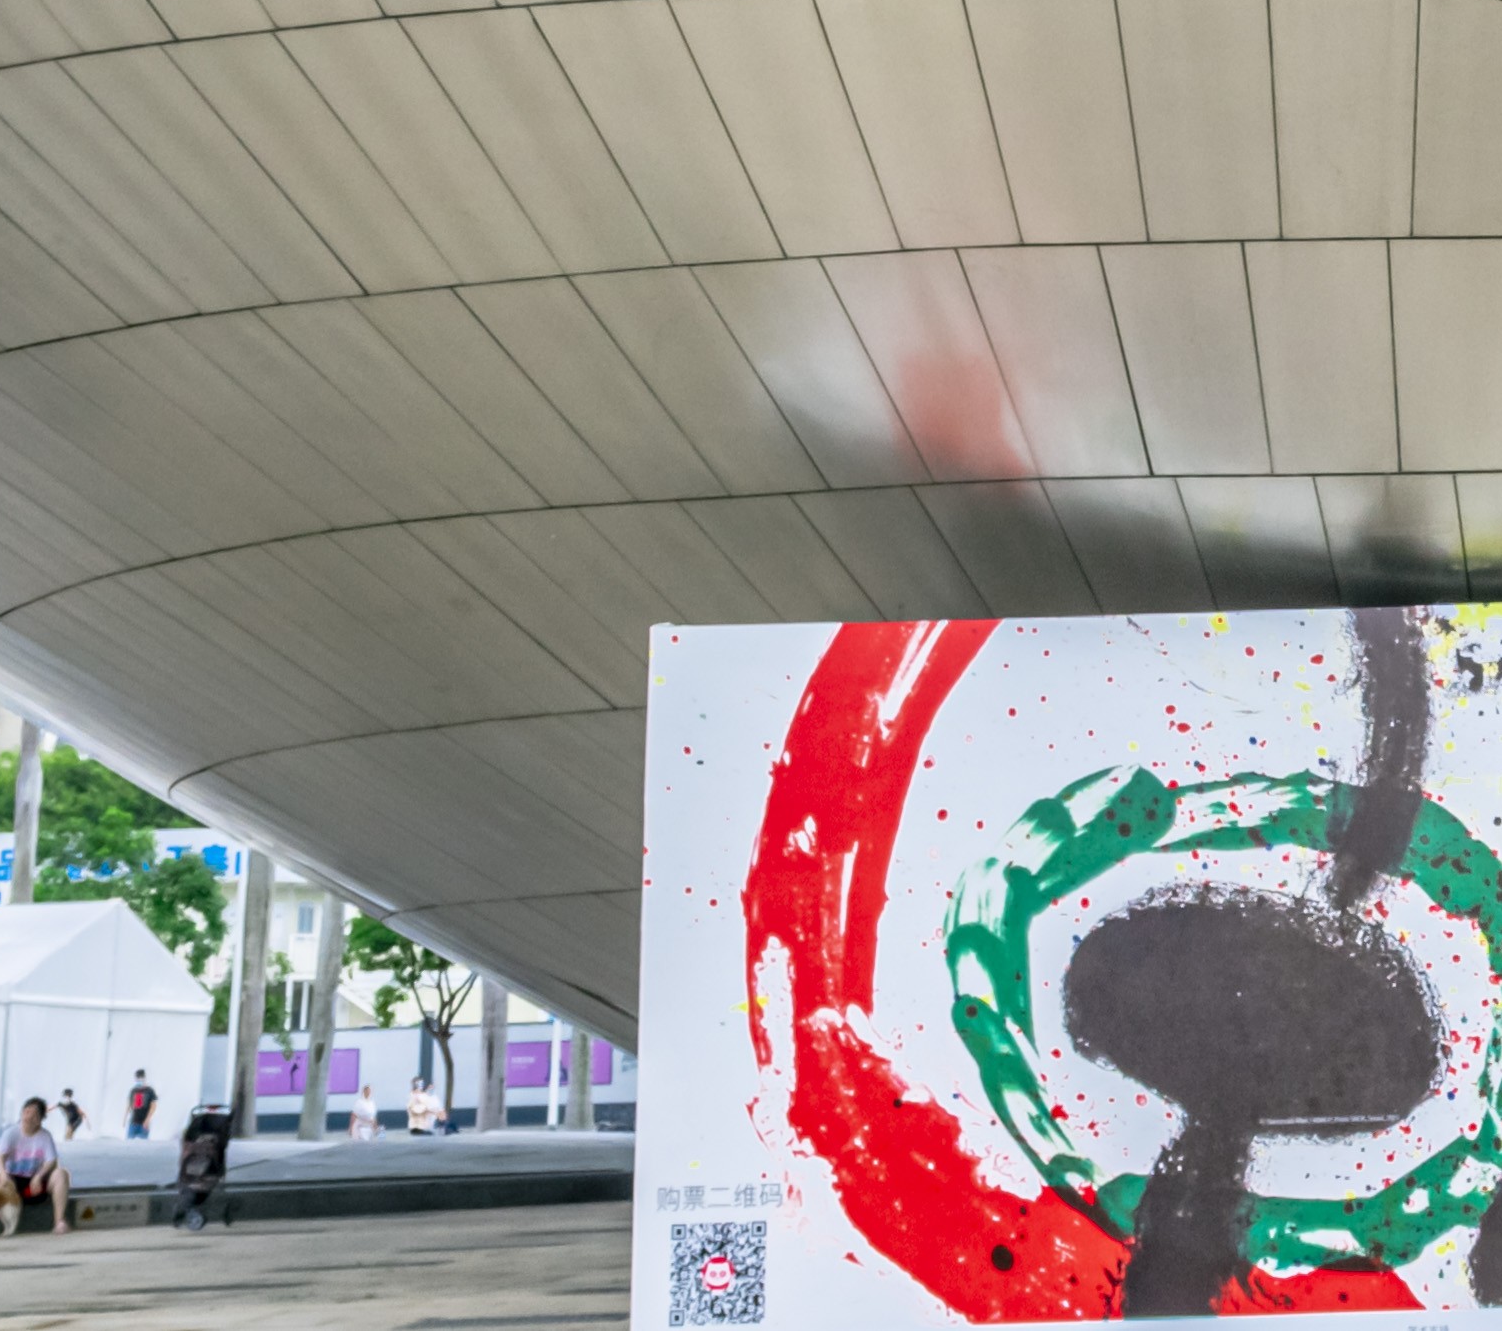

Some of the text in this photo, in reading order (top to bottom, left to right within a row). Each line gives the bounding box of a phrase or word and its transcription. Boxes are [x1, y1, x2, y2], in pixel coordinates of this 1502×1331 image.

[656, 1183, 784, 1212] 购票二维码
